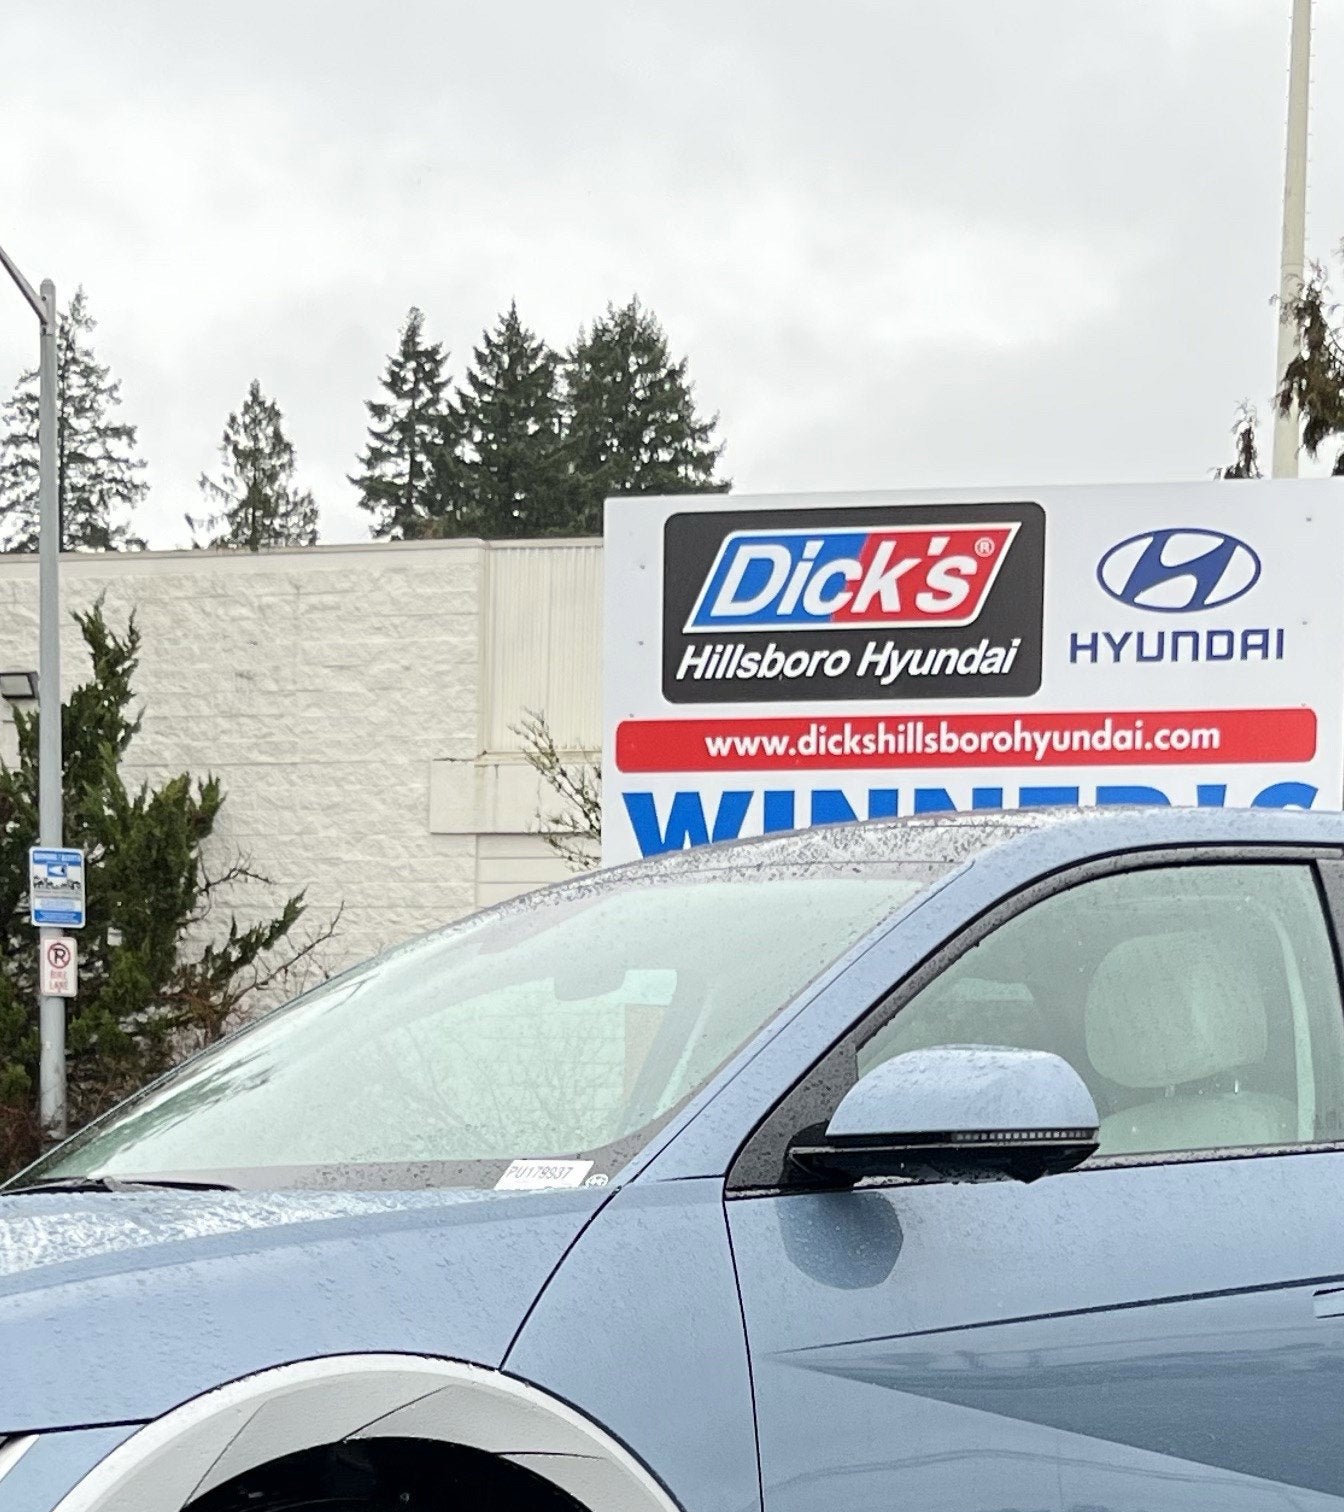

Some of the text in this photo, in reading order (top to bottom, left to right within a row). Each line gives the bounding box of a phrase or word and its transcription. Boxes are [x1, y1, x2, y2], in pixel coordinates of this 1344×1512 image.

[675, 637, 1022, 687] Hillsboro Hyundai
[1070, 627, 1286, 665] HYUNDAI
[704, 719, 1221, 762] www.dickshillsborohyundai.com
